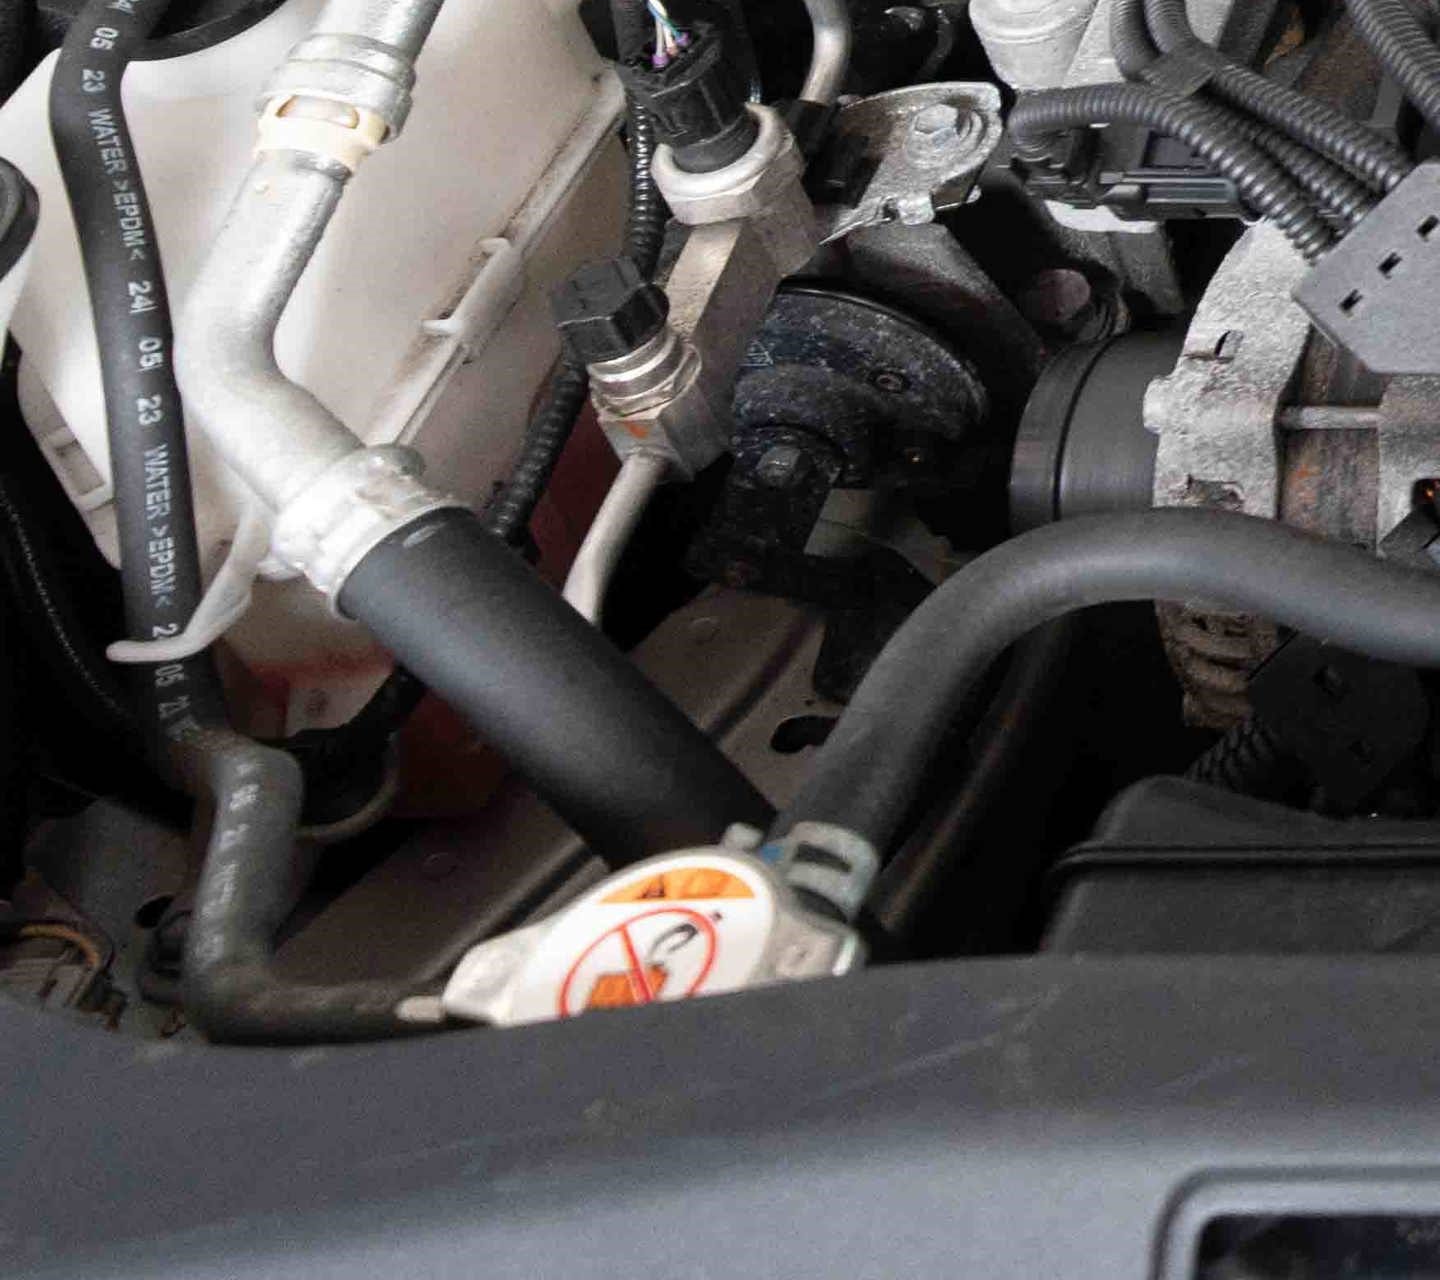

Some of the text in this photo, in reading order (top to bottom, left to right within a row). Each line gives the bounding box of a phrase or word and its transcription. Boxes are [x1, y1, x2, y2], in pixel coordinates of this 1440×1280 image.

[90, 27, 119, 50] 05
[82, 68, 106, 93] 23
[88, 108, 128, 175] WATER
[137, 394, 162, 426] 23
[144, 444, 172, 520] WATER
[152, 622, 179, 640] 2
[155, 663, 185, 688] 05
